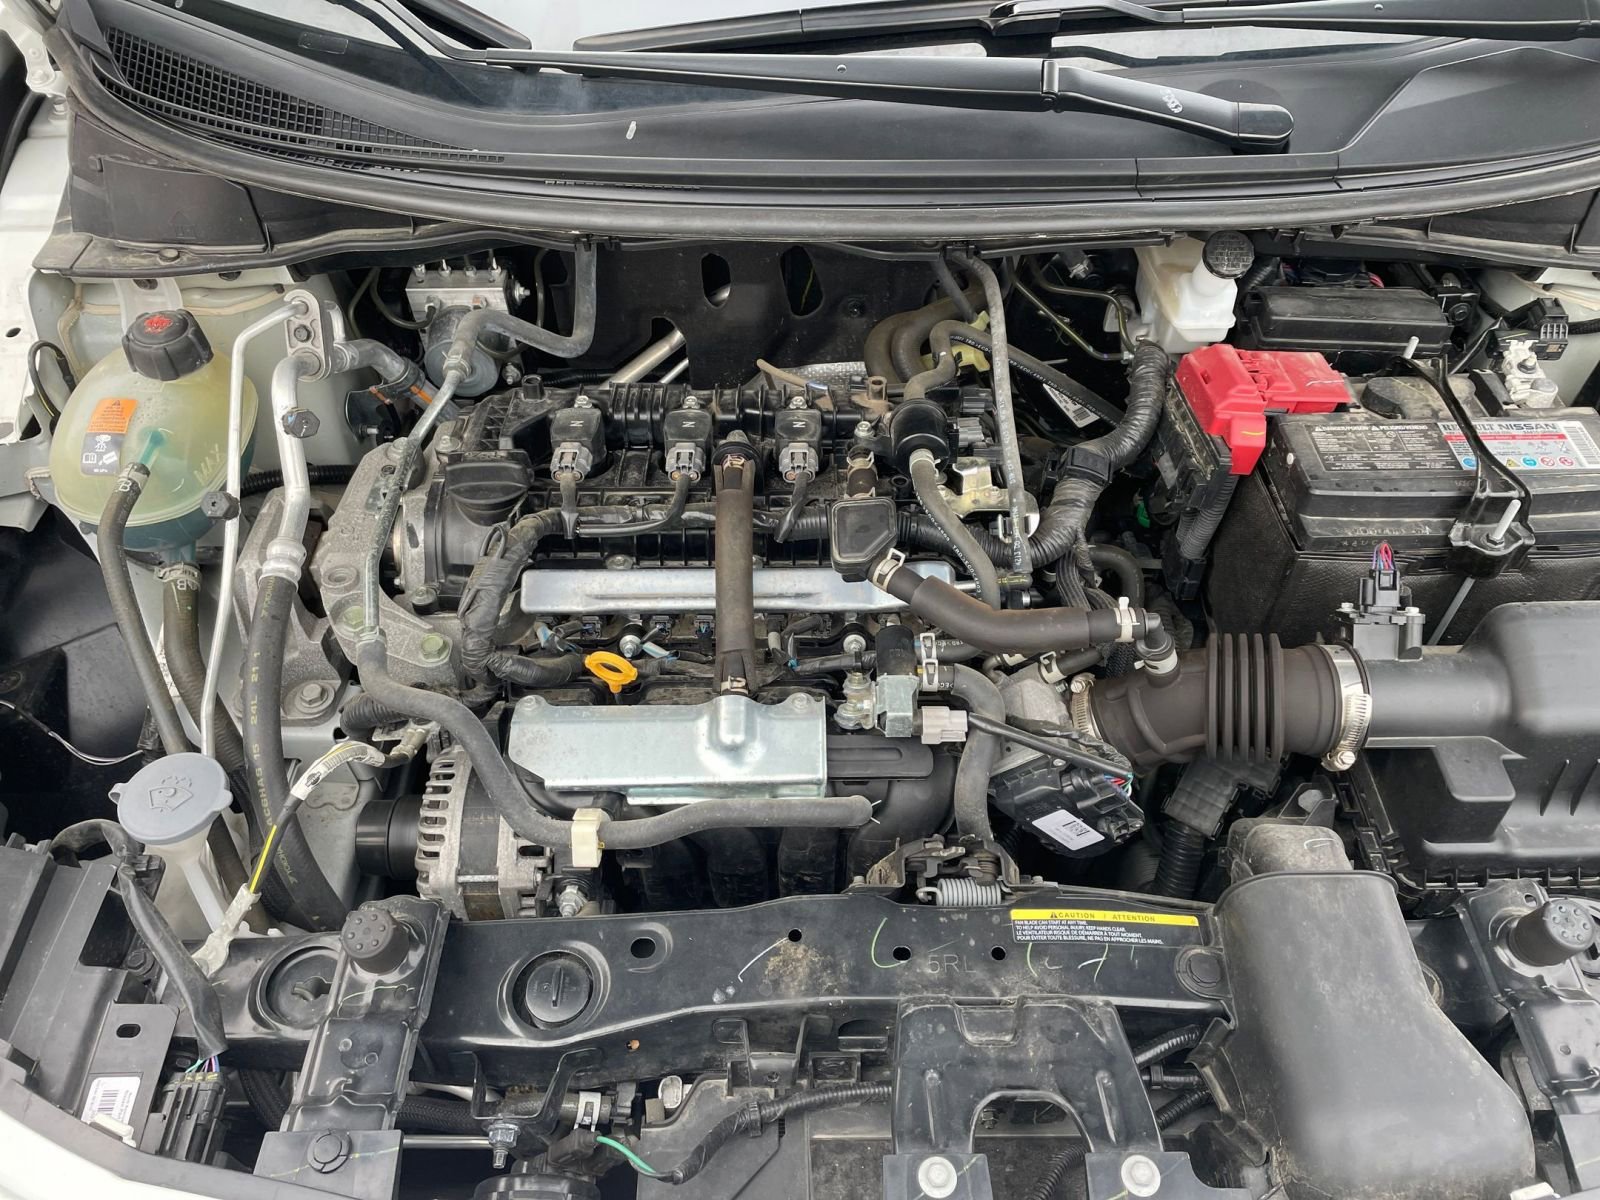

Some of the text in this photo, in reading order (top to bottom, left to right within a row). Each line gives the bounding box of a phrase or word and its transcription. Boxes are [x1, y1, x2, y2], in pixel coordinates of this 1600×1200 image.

[1442, 423, 1558, 431] REULT NISSAN
[253, 743, 261, 761] 15
[1112, 914, 1156, 922] ATTENTION
